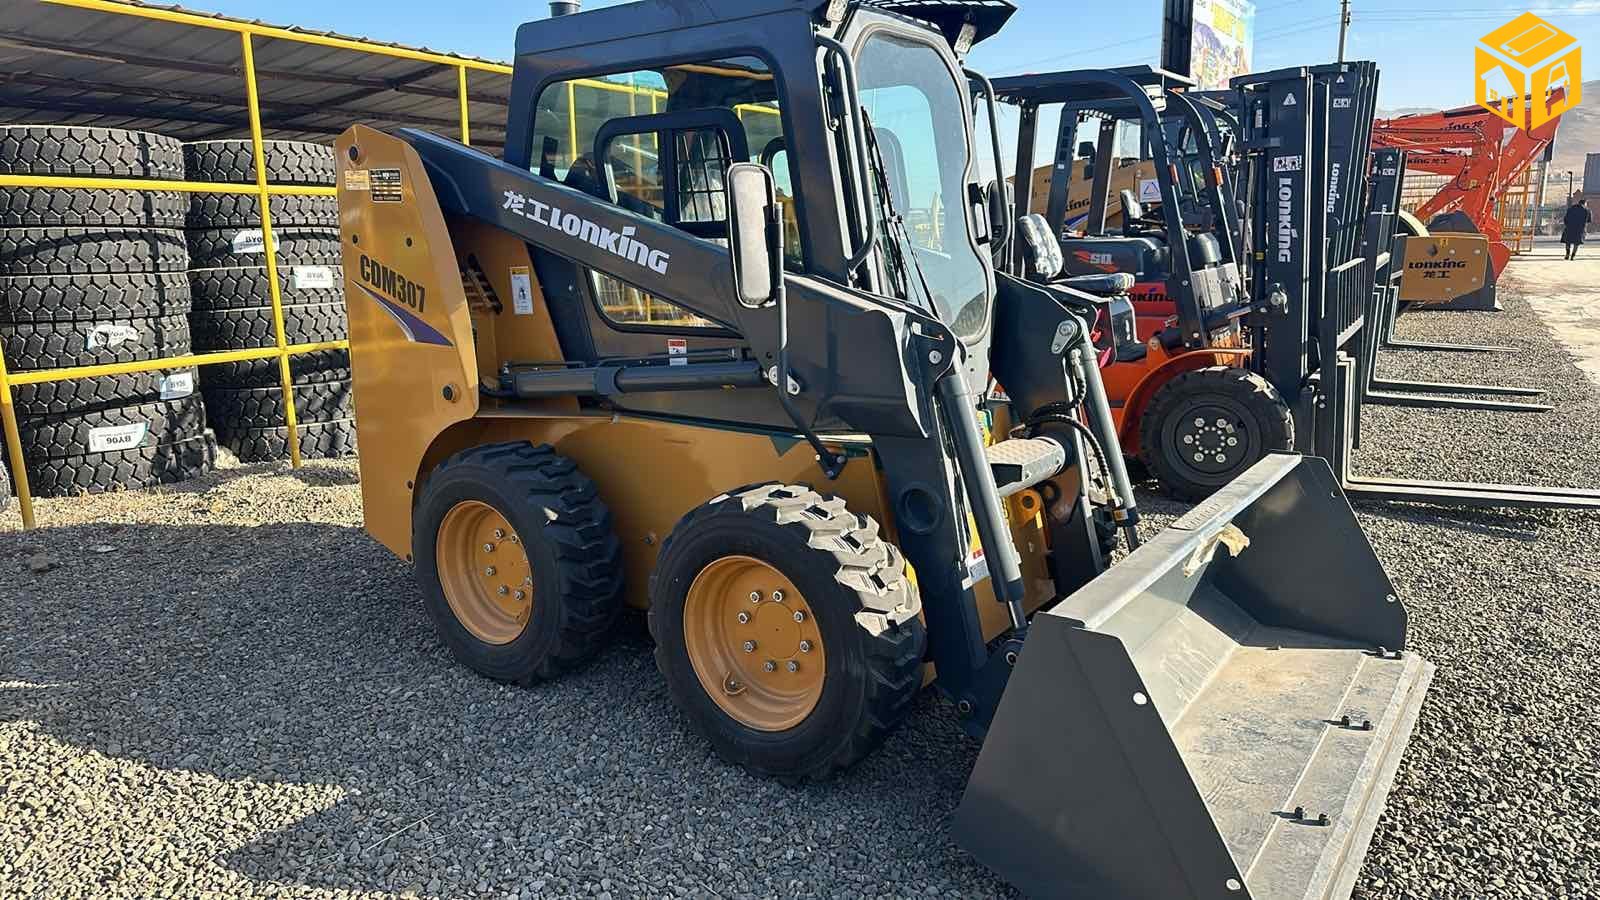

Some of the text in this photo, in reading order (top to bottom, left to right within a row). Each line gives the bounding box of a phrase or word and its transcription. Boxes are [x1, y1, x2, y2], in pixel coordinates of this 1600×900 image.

[502, 190, 671, 276] 龙工 LONKING
[1278, 178, 1298, 263] LONKING
[1408, 258, 1467, 269] LONKING
[1423, 270, 1450, 279] 龙工
[360, 254, 426, 313] CDM307
[106, 435, 131, 445] BY06
